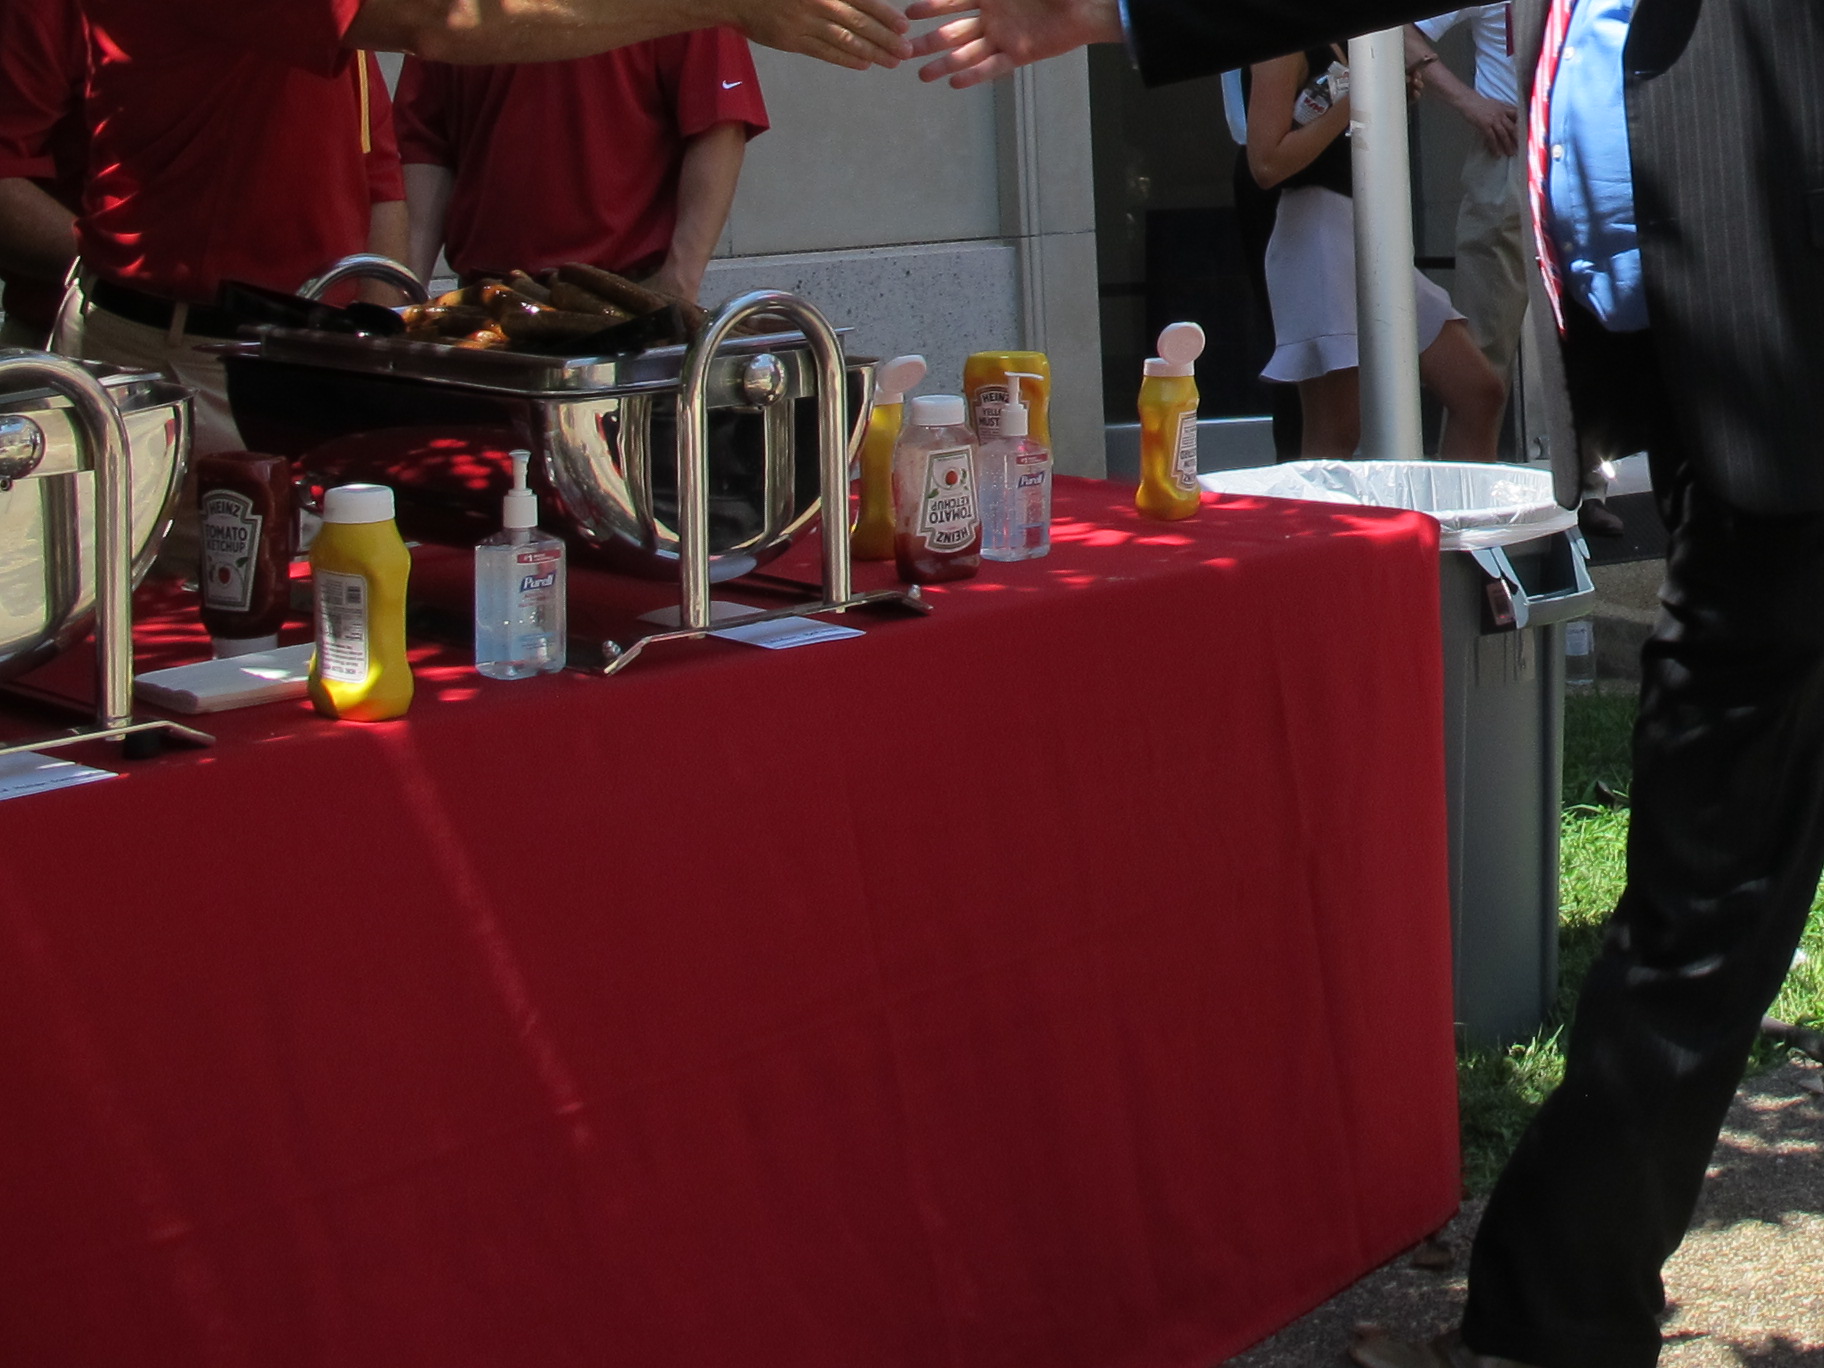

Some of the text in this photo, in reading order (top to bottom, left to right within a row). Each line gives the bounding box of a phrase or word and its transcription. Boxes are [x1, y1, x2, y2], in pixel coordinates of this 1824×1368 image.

[982, 392, 1010, 403] HEINZ
[209, 500, 240, 518] HEINZ
[931, 495, 970, 511] KETCHUP
[929, 506, 972, 524] TOMATO
[205, 524, 247, 541] TOMATO
[936, 527, 969, 543] HEINZ
[206, 539, 246, 553] KETCHUP
[523, 573, 555, 590] Purell
